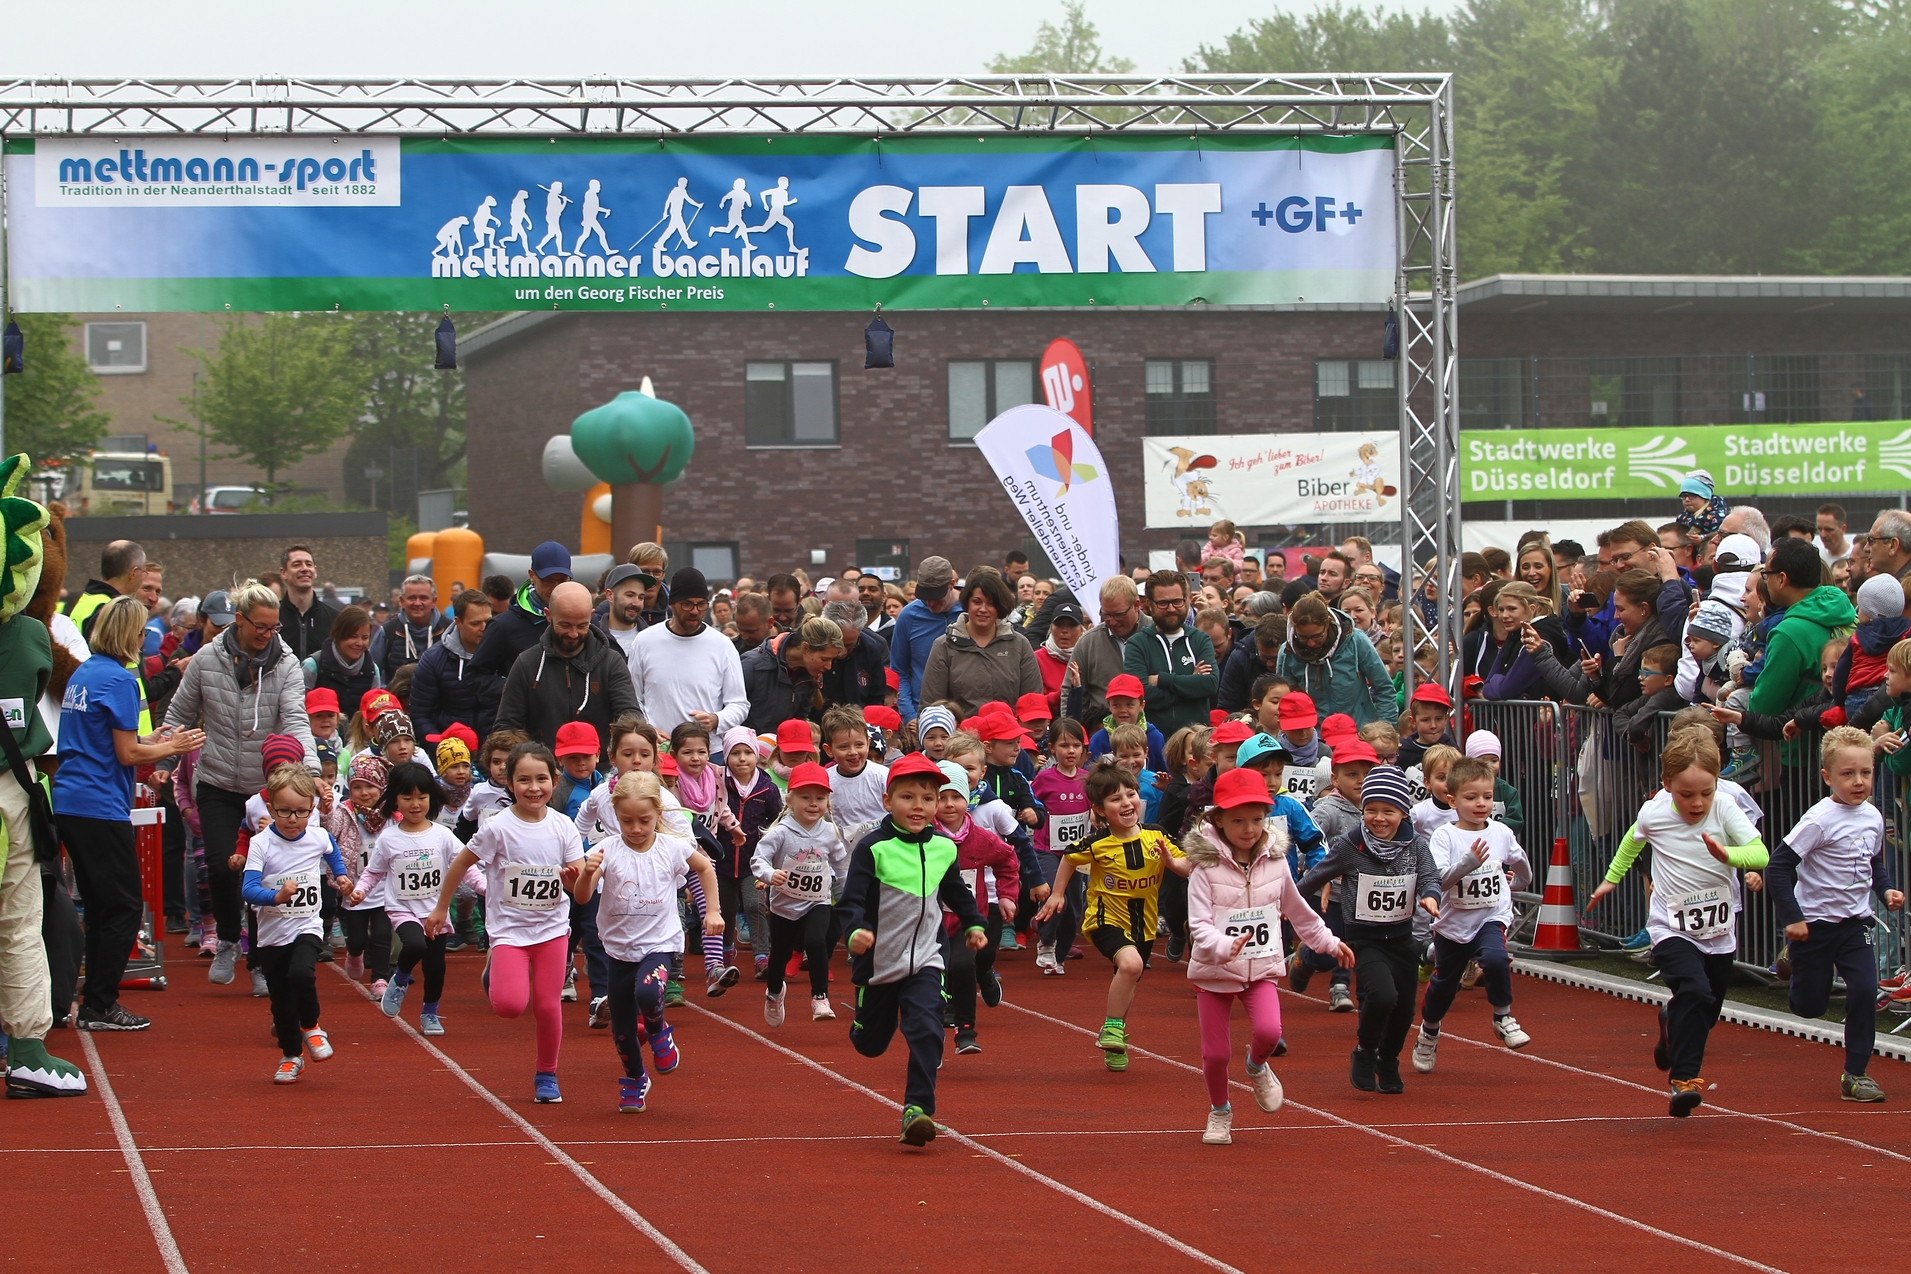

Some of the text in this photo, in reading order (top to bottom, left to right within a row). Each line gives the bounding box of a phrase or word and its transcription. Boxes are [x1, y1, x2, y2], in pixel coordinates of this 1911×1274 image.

[59, 149, 377, 191] mettmann-sport
[59, 184, 376, 196] Tradition in der Neanderthalstadt seit 1882
[843, 183, 1222, 279] START
[431, 247, 809, 278] mettmanner bachlauf
[515, 284, 724, 303] um den Georg Fischer Preis
[1470, 436, 1617, 462] Stadtwerke
[1724, 430, 1868, 457] Stadtwerke
[1228, 458, 1245, 471] Ich
[1274, 449, 1324, 476] zum Biber!
[1725, 459, 1867, 486] Düsseldorf
[1298, 478, 1350, 497] Biber
[1471, 466, 1616, 492] Düsseldorf
[1313, 498, 1372, 511] APOTHEKE
[1408, 780, 1432, 802] 59
[1058, 824, 1085, 842] 650
[403, 848, 435, 858] CHERRY
[398, 869, 441, 891] 1348
[509, 877, 560, 900] 1428
[787, 871, 823, 892] 598
[1454, 874, 1500, 899] 1435
[1367, 890, 1407, 912] 654
[1673, 902, 1729, 931] 1370
